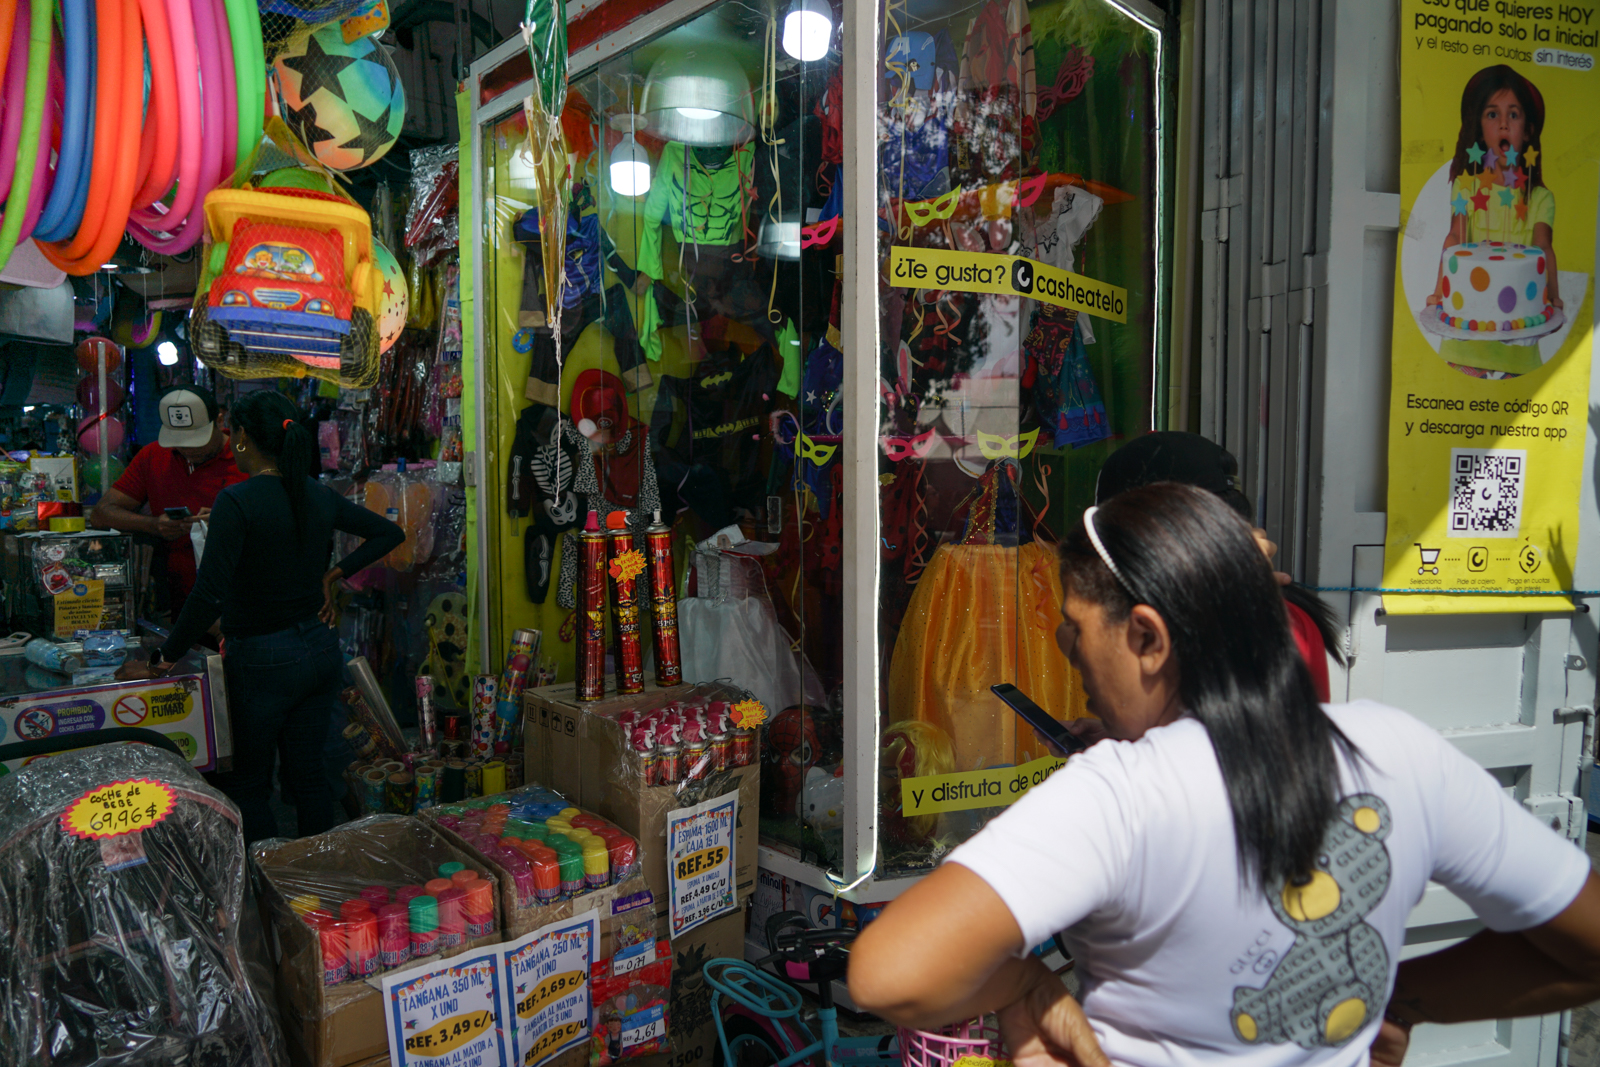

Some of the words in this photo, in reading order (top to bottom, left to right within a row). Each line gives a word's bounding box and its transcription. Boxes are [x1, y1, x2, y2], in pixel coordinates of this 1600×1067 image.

[1455, 0, 1489, 14] que
[1495, 1, 1553, 20] quieres
[1558, 4, 1594, 25] HOY
[1415, 13, 1493, 34] pagando
[1498, 22, 1527, 41] solo
[1533, 24, 1550, 42] la
[1555, 26, 1599, 48] inicial
[1415, 36, 1424, 50] y
[1427, 36, 1437, 50] el
[1441, 39, 1469, 54] resto
[1473, 44, 1490, 56] en
[1495, 45, 1532, 62] cuotas
[1536, 49, 1553, 64] sin
[1557, 51, 1593, 69] interés
[894, 257, 928, 279] ¿Te
[935, 263, 1006, 286] gusta?
[1036, 273, 1124, 316] casheatelo
[1406, 394, 1464, 412] Escanea
[1469, 398, 1500, 413] este
[1504, 398, 1548, 418] código
[1551, 401, 1569, 416] QR
[1405, 421, 1415, 436] y
[1419, 419, 1485, 439] descarga
[1489, 423, 1540, 438] nuestra
[1543, 425, 1568, 442] app
[1507, 578, 1522, 586] Paga
[57, 705, 93, 717] PROHIBIDO
[58, 716, 83, 726] INGRESAR
[152, 702, 185, 718] FUMAR
[90, 789, 122, 804] COCHE
[912, 789, 925, 808] y
[931, 778, 1002, 802] disfruta
[1009, 774, 1029, 794] de
[678, 825, 702, 843] ESPUMA
[705, 820, 719, 835] 1500
[720, 815, 728, 829] ML
[686, 838, 704, 853] CAJA
[705, 835, 713, 847] 15
[714, 833, 719, 845] U
[678, 847, 723, 879] REF.55
[680, 884, 710, 905] REF.4.49
[712, 878, 726, 891] C/U
[760, 874, 790, 894] minala
[684, 913, 698, 924] REF.
[711, 899, 723, 913] C/U
[514, 947, 551, 977] TANGANA
[552, 939, 567, 956] 250
[570, 937, 582, 951] ML
[536, 967, 541, 981] X
[541, 959, 557, 976] UND
[402, 984, 450, 1013] TANGANA
[452, 976, 470, 994] 350
[470, 971, 485, 988] ML
[517, 994, 539, 1015] REF.
[540, 978, 565, 999] 2,69
[568, 970, 589, 986] c/u
[431, 1005, 438, 1020] X
[440, 998, 458, 1017] UND
[524, 1011, 547, 1035] TANGANA
[548, 1007, 555, 1018] AL
[556, 996, 577, 1011] MAYOR
[578, 994, 584, 1003] A
[405, 1034, 437, 1051] REF.
[440, 1020, 470, 1043] 3,49
[474, 1010, 498, 1028] c/u
[532, 1023, 548, 1041] PARTIR
[548, 1018, 555, 1027] DE
[560, 1009, 573, 1021] UND
[634, 1022, 656, 1043] 2,69
[414, 1056, 451, 1067] TANGANA
[452, 1050, 462, 1064] AL
[463, 1040, 486, 1061] MAYOR
[488, 1037, 494, 1049] A
[468, 1055, 482, 1067] UND
[667, 1045, 704, 1067] 1500
